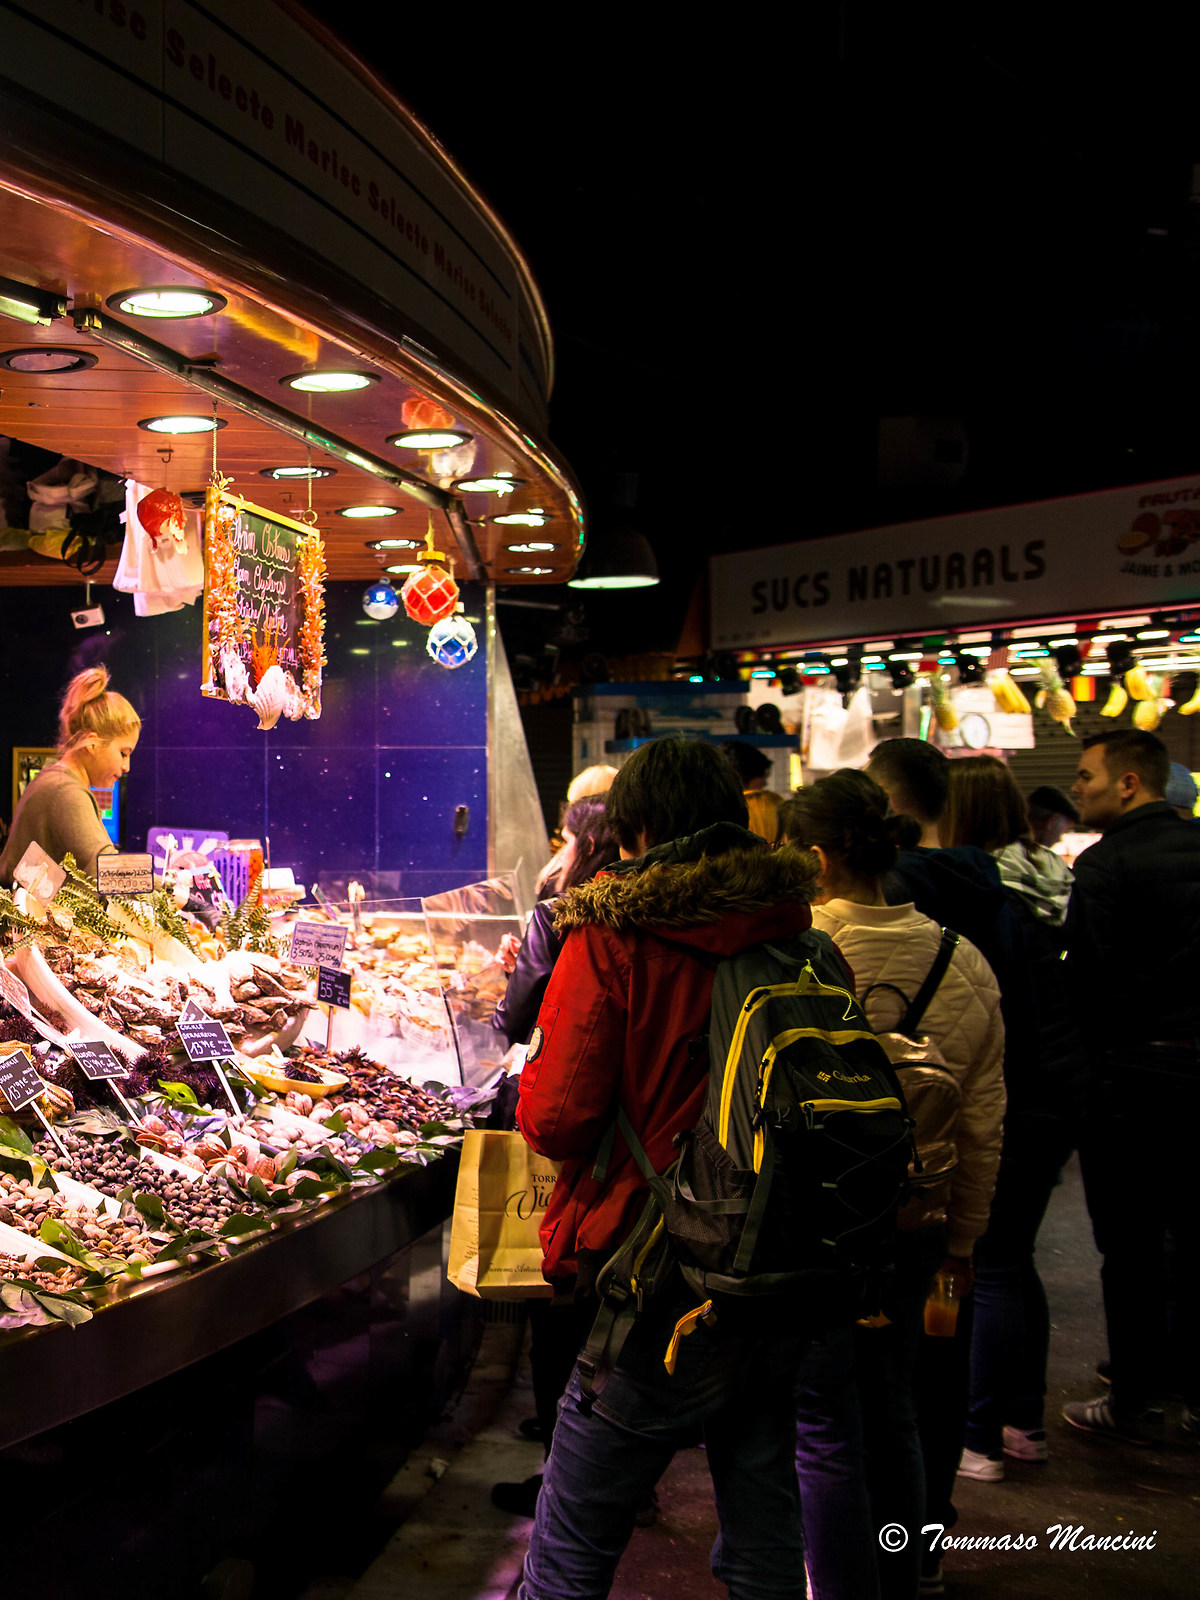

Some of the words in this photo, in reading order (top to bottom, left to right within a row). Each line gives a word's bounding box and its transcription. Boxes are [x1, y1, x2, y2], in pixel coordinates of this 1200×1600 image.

[166, 28, 274, 130] Selecte
[284, 113, 362, 197] Marisc
[367, 180, 429, 256] Selecte
[752, 571, 832, 615] SUCS
[847, 539, 1047, 602] NATURALS
[1121, 562, 1159, 577] JAIME
[1164, 563, 1174, 577] &
[531, 1173, 558, 1184] TORR
